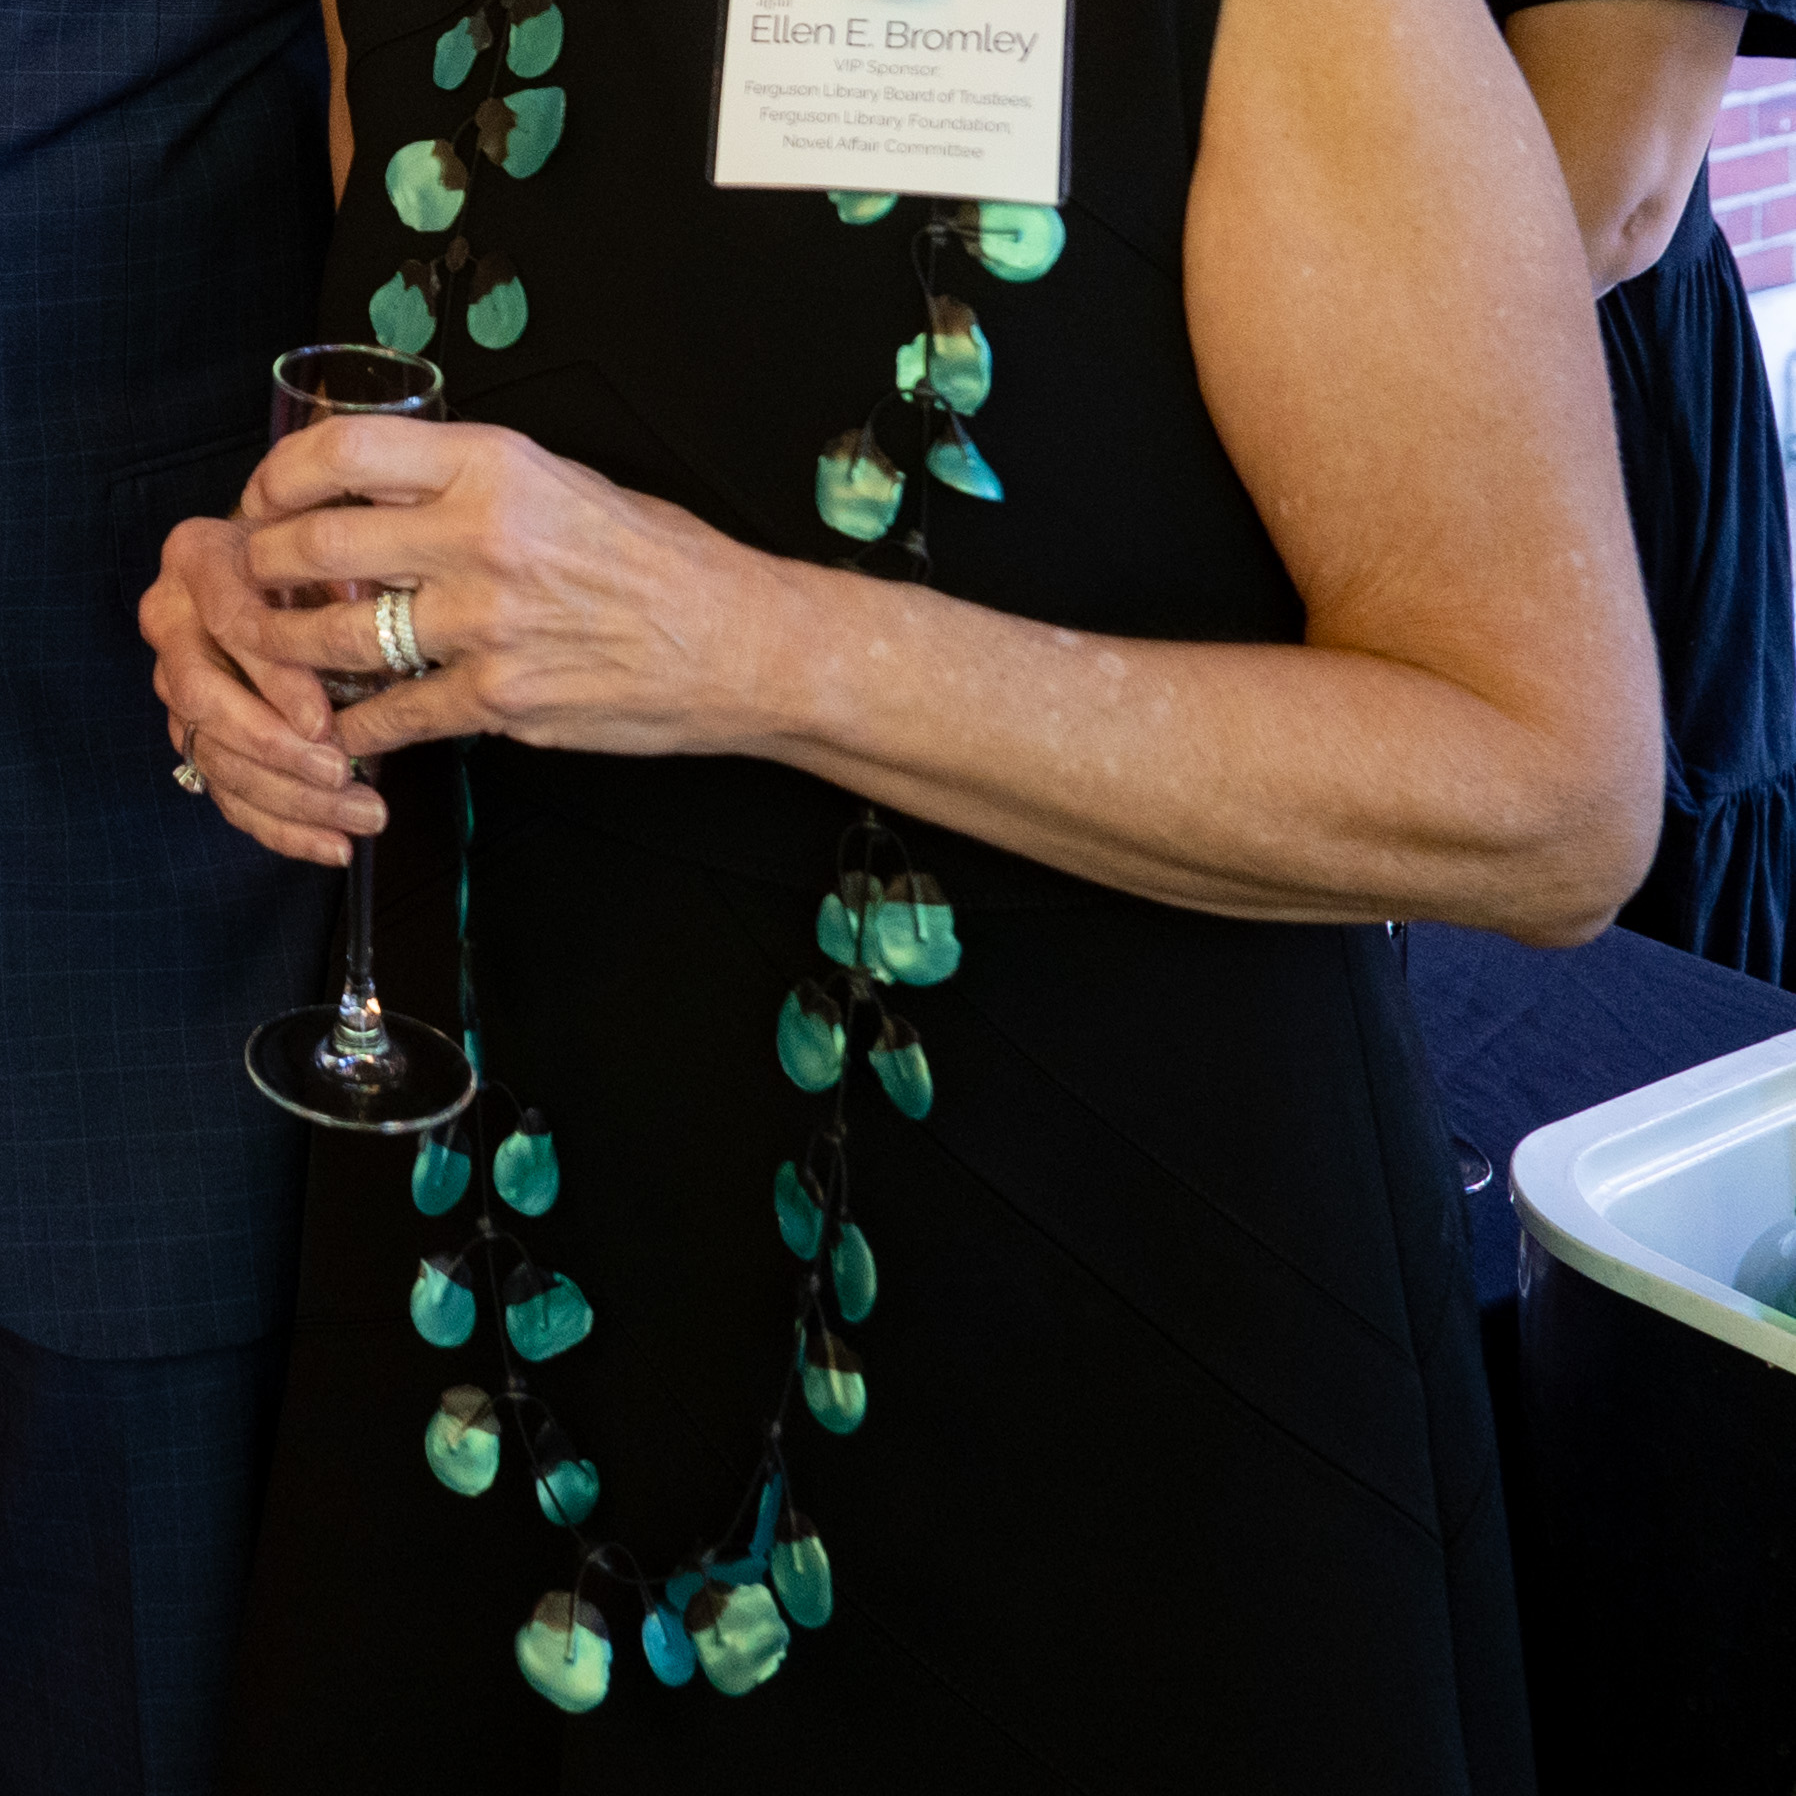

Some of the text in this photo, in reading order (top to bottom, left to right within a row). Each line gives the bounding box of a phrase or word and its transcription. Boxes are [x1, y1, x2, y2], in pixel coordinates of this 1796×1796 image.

[750, 14, 1039, 62] Ellen E. Bromley
[834, 58, 864, 72] VIP
[744, 80, 818, 99] Ferguson
[823, 83, 878, 102] Library
[883, 86, 935, 102] Board
[936, 88, 955, 103] of
[758, 106, 839, 125] Ferguson
[843, 110, 902, 132] Library
[782, 135, 984, 158] Novel Affair Committee
